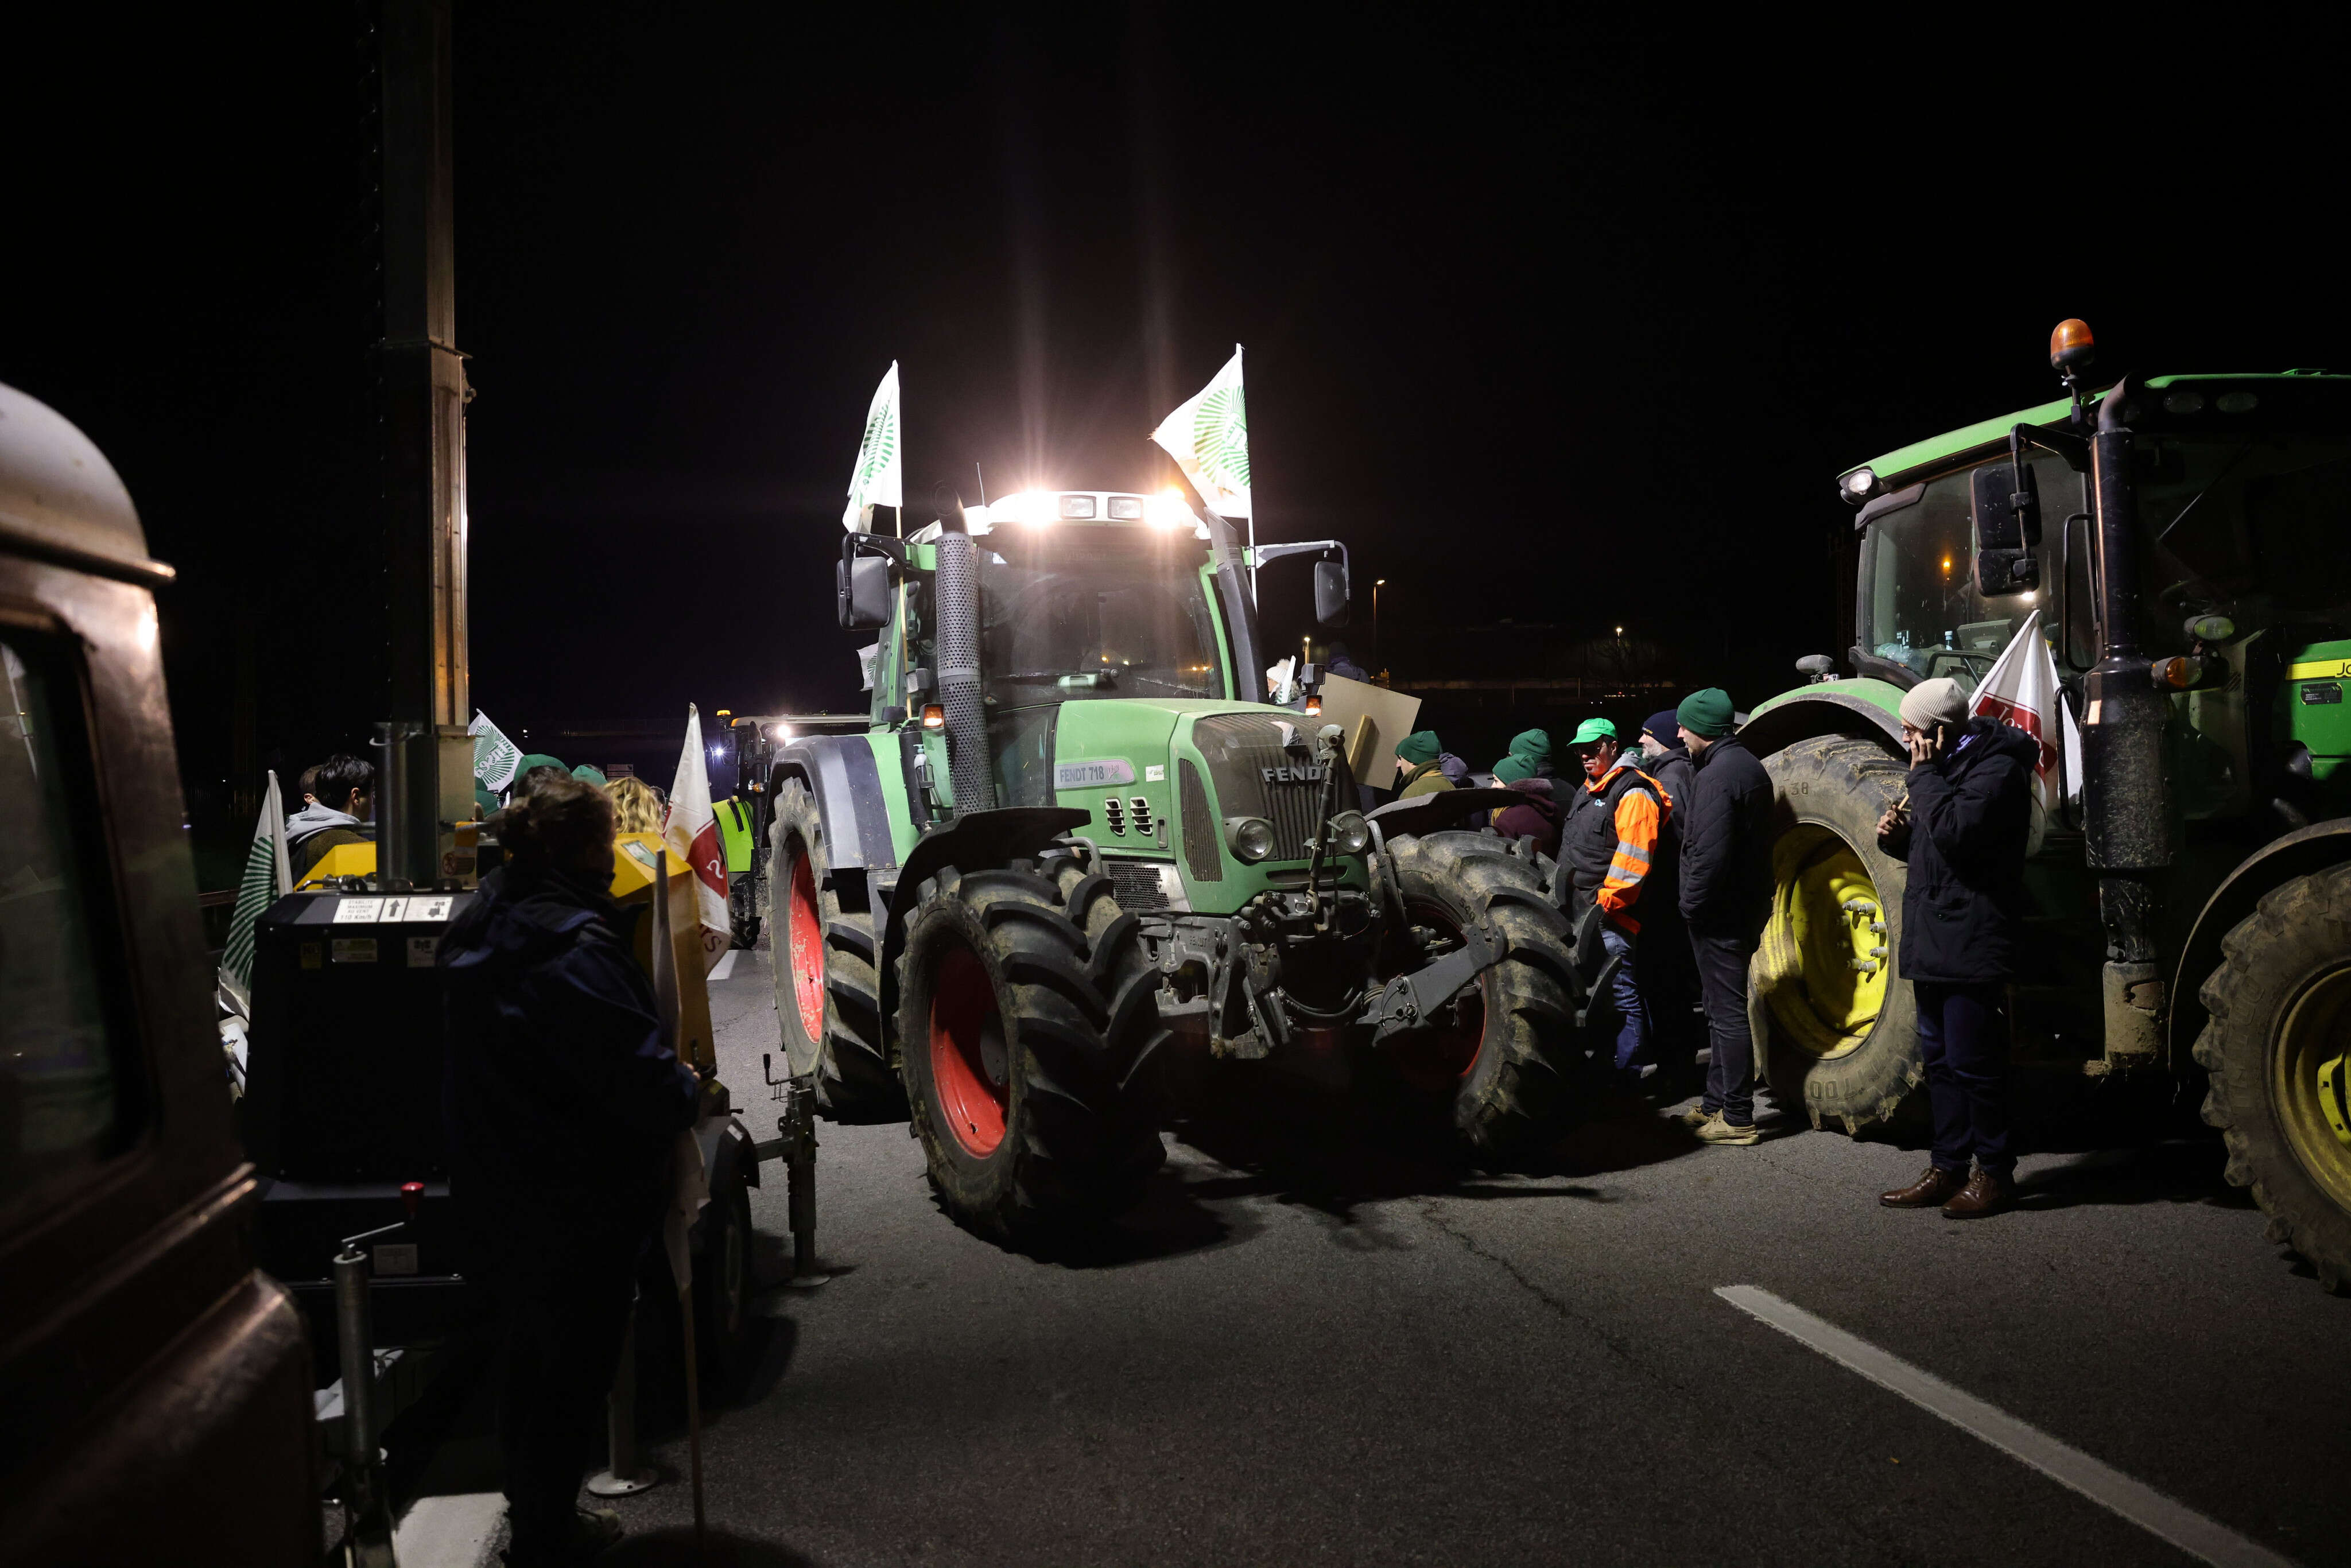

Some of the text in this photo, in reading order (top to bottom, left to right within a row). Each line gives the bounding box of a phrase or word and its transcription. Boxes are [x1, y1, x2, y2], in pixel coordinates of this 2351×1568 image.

[1060, 767, 1087, 783] FENDT
[1088, 766, 1105, 781] 718
[1261, 766, 1322, 782] FEND
[1791, 782, 1809, 796] 38
